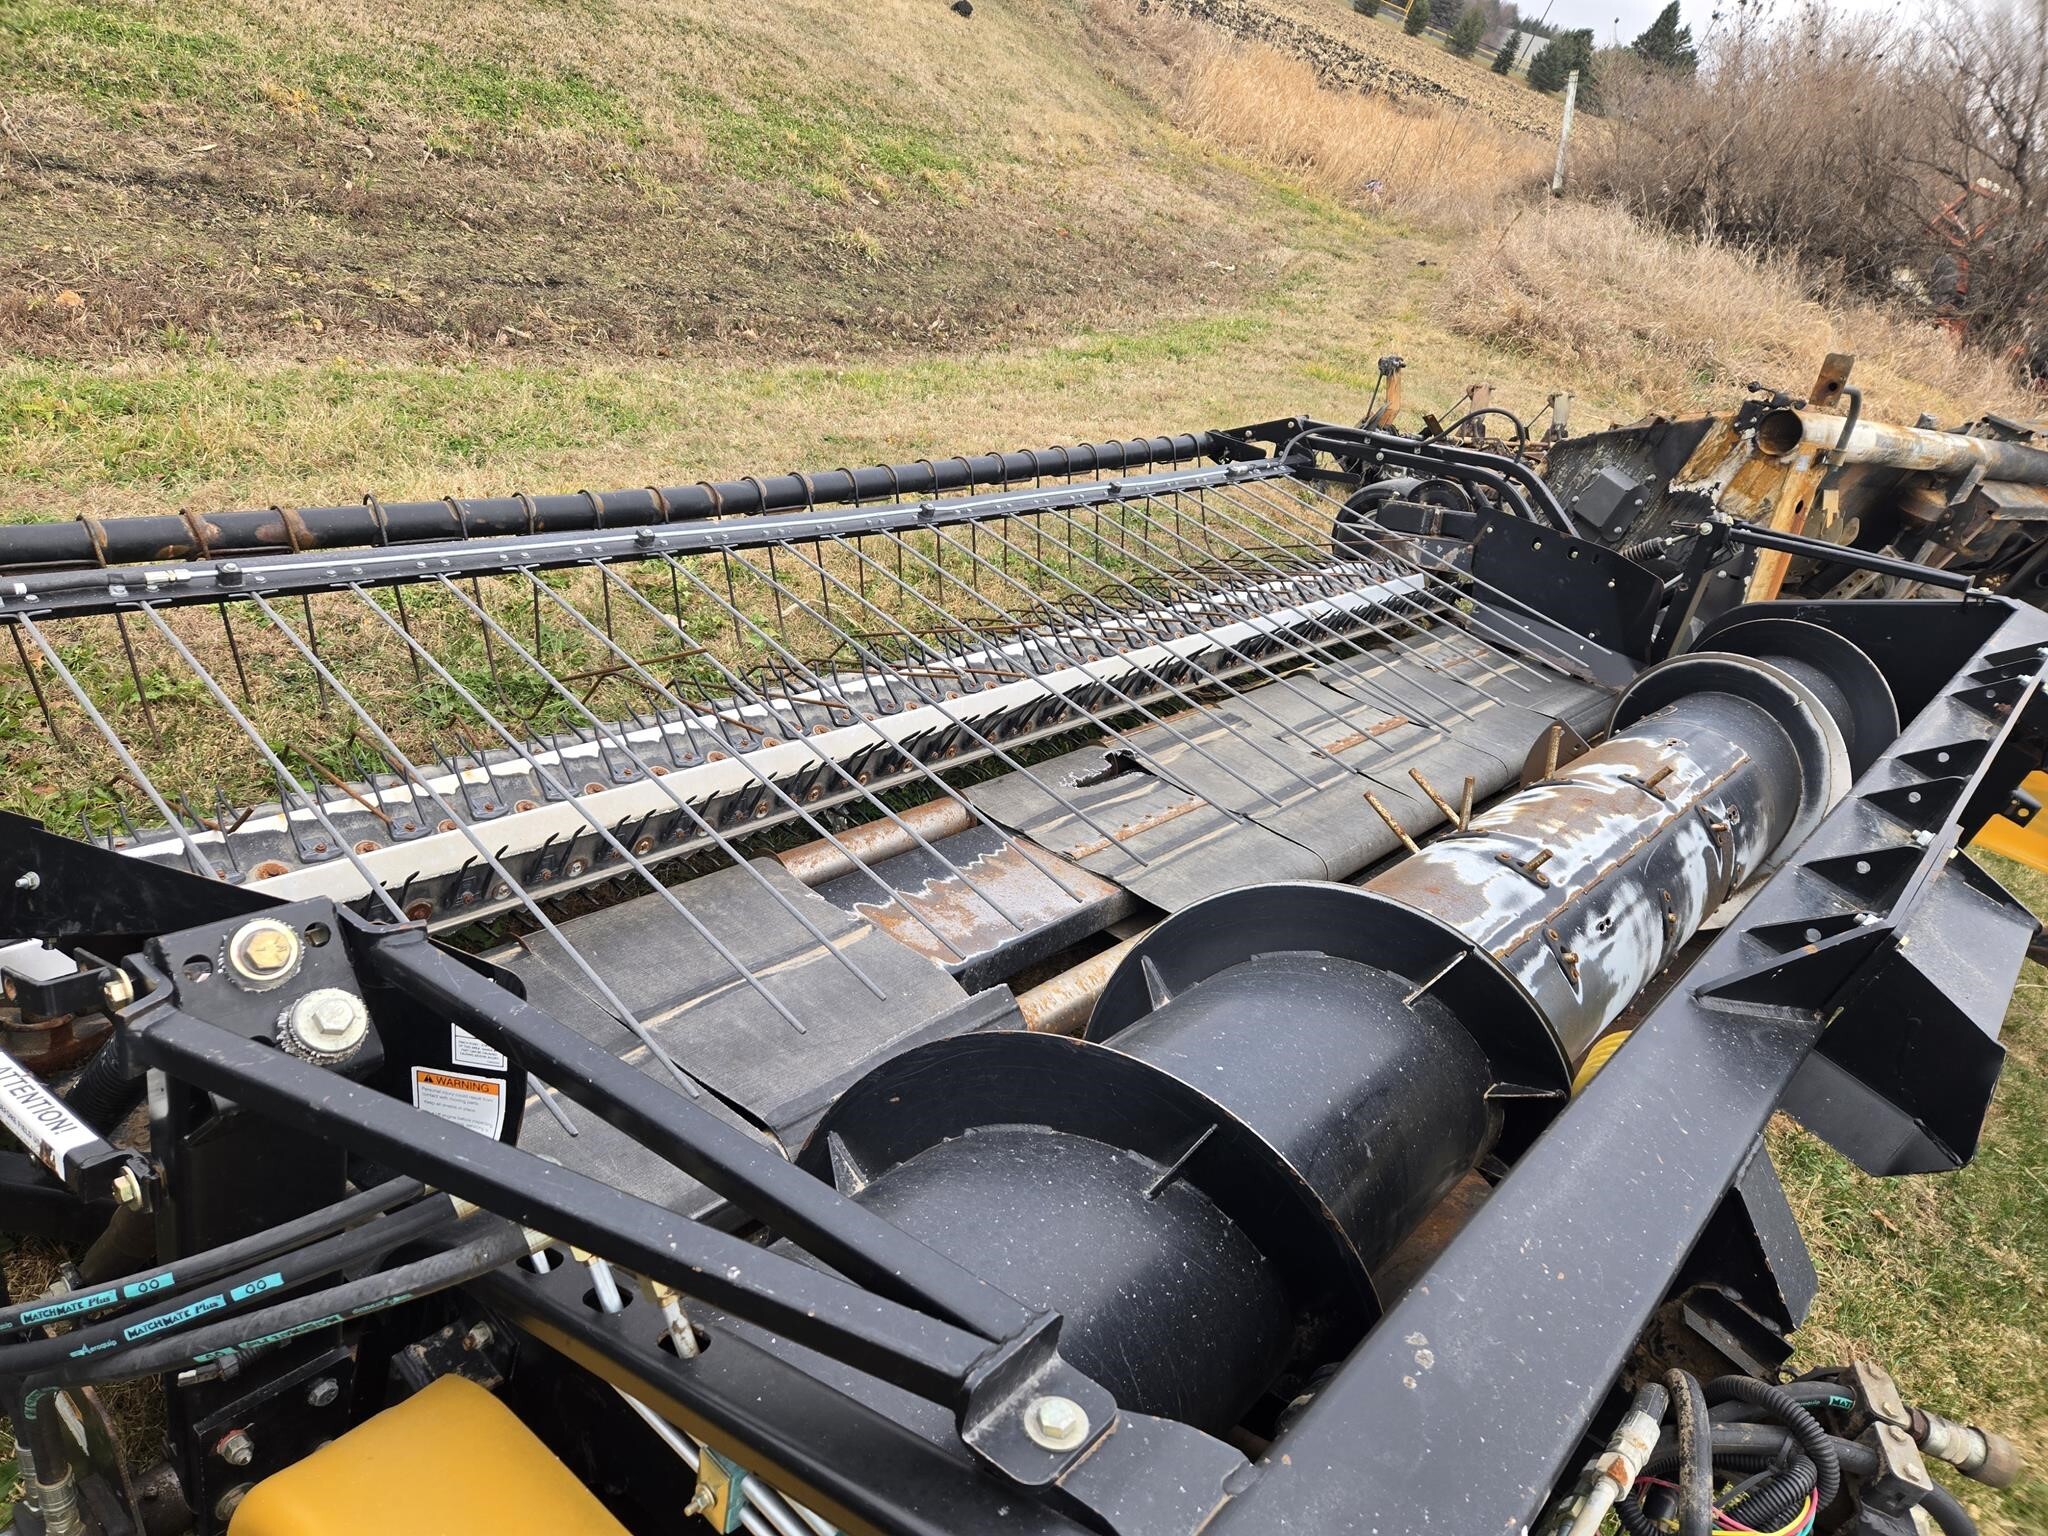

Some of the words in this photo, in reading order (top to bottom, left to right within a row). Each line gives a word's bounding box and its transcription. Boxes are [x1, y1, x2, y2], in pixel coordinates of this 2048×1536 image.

[436, 1076, 490, 1093] WARNING
[22, 1301, 84, 1323] MATCHMATE
[88, 1296, 111, 1307] Plus
[127, 1310, 192, 1339] MATCHMATE
[195, 1301, 220, 1315] Plus
[1832, 1398, 1851, 1408] MAT
